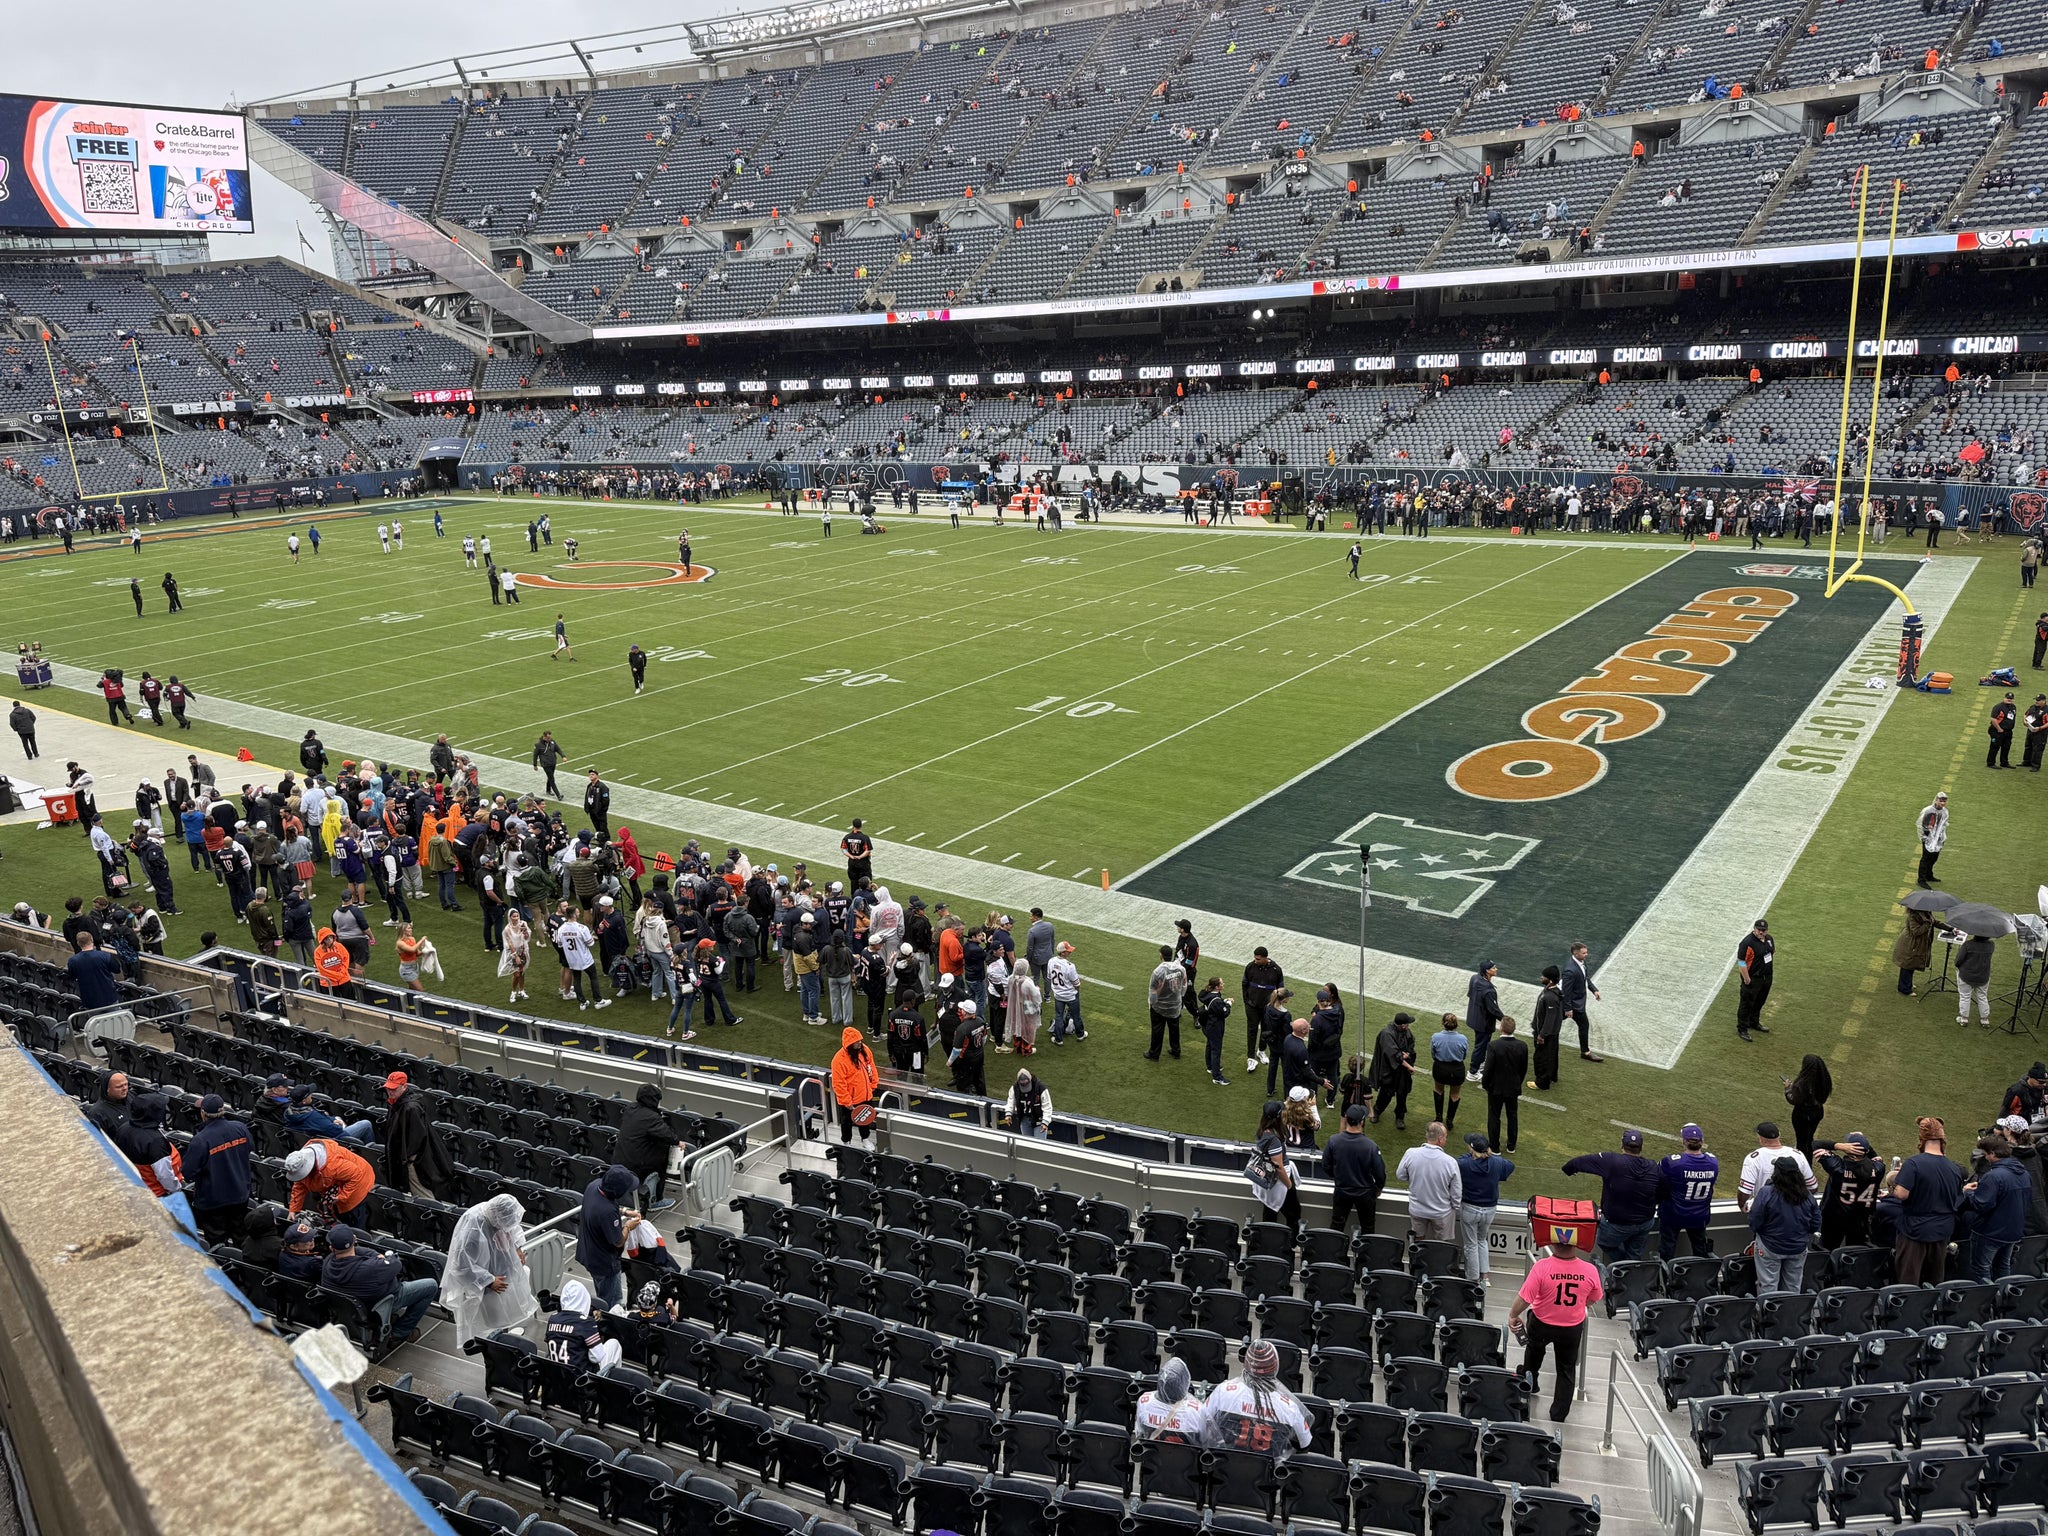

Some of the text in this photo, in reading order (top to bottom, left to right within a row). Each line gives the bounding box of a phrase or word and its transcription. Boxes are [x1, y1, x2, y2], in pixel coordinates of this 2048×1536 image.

[73, 121, 129, 136] Join for
[156, 122, 235, 139] Crate&Barrel
[76, 138, 130, 156] FREE
[181, 141, 199, 149] official
[217, 144, 239, 152] partner
[188, 148, 210, 157] Chicago
[196, 191, 213, 204] Lite
[218, 209, 234, 217] CHI
[173, 402, 238, 414] BEAR
[285, 395, 346, 408] DOWN
[133, 411, 147, 421] 34
[800, 668, 890, 687] 20
[1444, 586, 1800, 803] CHICAGO
[1821, 679, 1888, 708] ALL
[1014, 695, 1117, 718] 10
[1803, 715, 1867, 741] OF
[1776, 745, 1848, 775] US
[52, 799, 68, 815] G
[223, 859, 234, 872] 18
[829, 907, 848, 925] 54
[566, 937, 578, 952] 31
[1051, 969, 1065, 987] 26
[894, 1018, 914, 1026] SECURITY
[209, 1137, 248, 1156] BEARS
[1684, 1170, 1715, 1179] TARKENTON
[1685, 1181, 1711, 1201] 10
[1839, 1181, 1876, 1208] 54
[1490, 1232, 1507, 1249] 03
[1549, 1273, 1586, 1282] VENDOR
[1553, 1282, 1579, 1307] 15
[548, 1323, 574, 1334] LOVELAND
[548, 1339, 570, 1364] 84
[1234, 1417, 1274, 1452] 18
